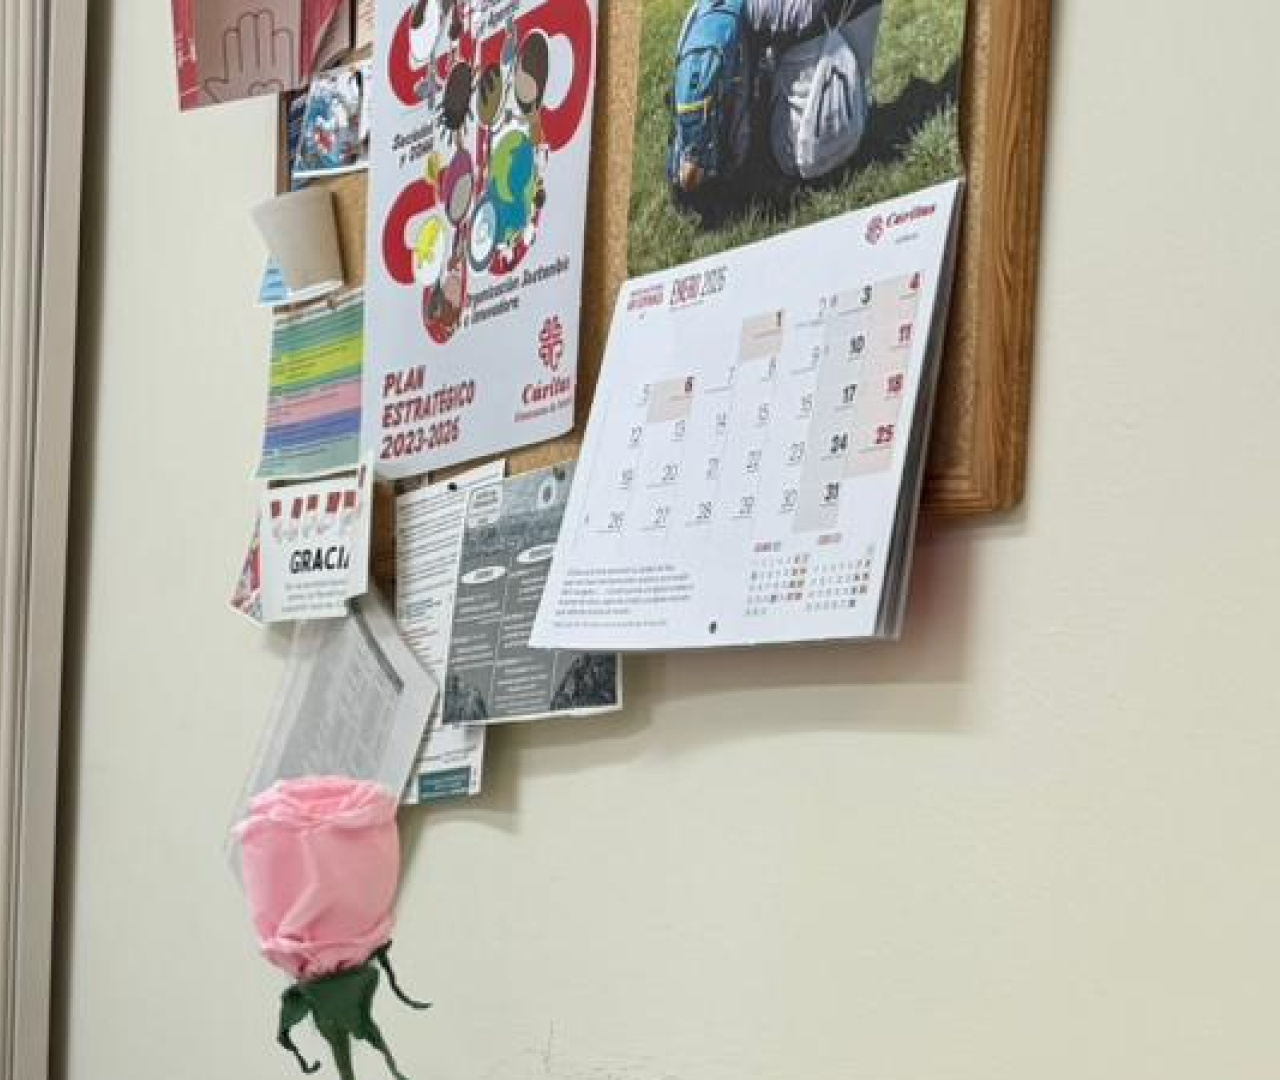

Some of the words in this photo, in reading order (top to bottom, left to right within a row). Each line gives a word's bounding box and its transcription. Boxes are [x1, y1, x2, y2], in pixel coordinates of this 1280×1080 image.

[775, 311, 784, 327] 1
[861, 286, 872, 304] 3
[909, 272, 922, 290] 4
[383, 364, 427, 399] PLAN
[684, 376, 694, 394] 6
[850, 334, 866, 355] 10
[898, 324, 913, 342] 11
[382, 378, 476, 428] ESTRATÉGICO
[842, 383, 858, 402] 17
[887, 372, 905, 393] 18
[380, 416, 461, 460] 2023-2026
[662, 463, 678, 483] 20
[831, 434, 849, 454] 24
[875, 424, 895, 445] 25
[608, 511, 625, 530] 26
[653, 505, 671, 526] 27
[697, 501, 714, 521] 28
[824, 482, 841, 502] 31
